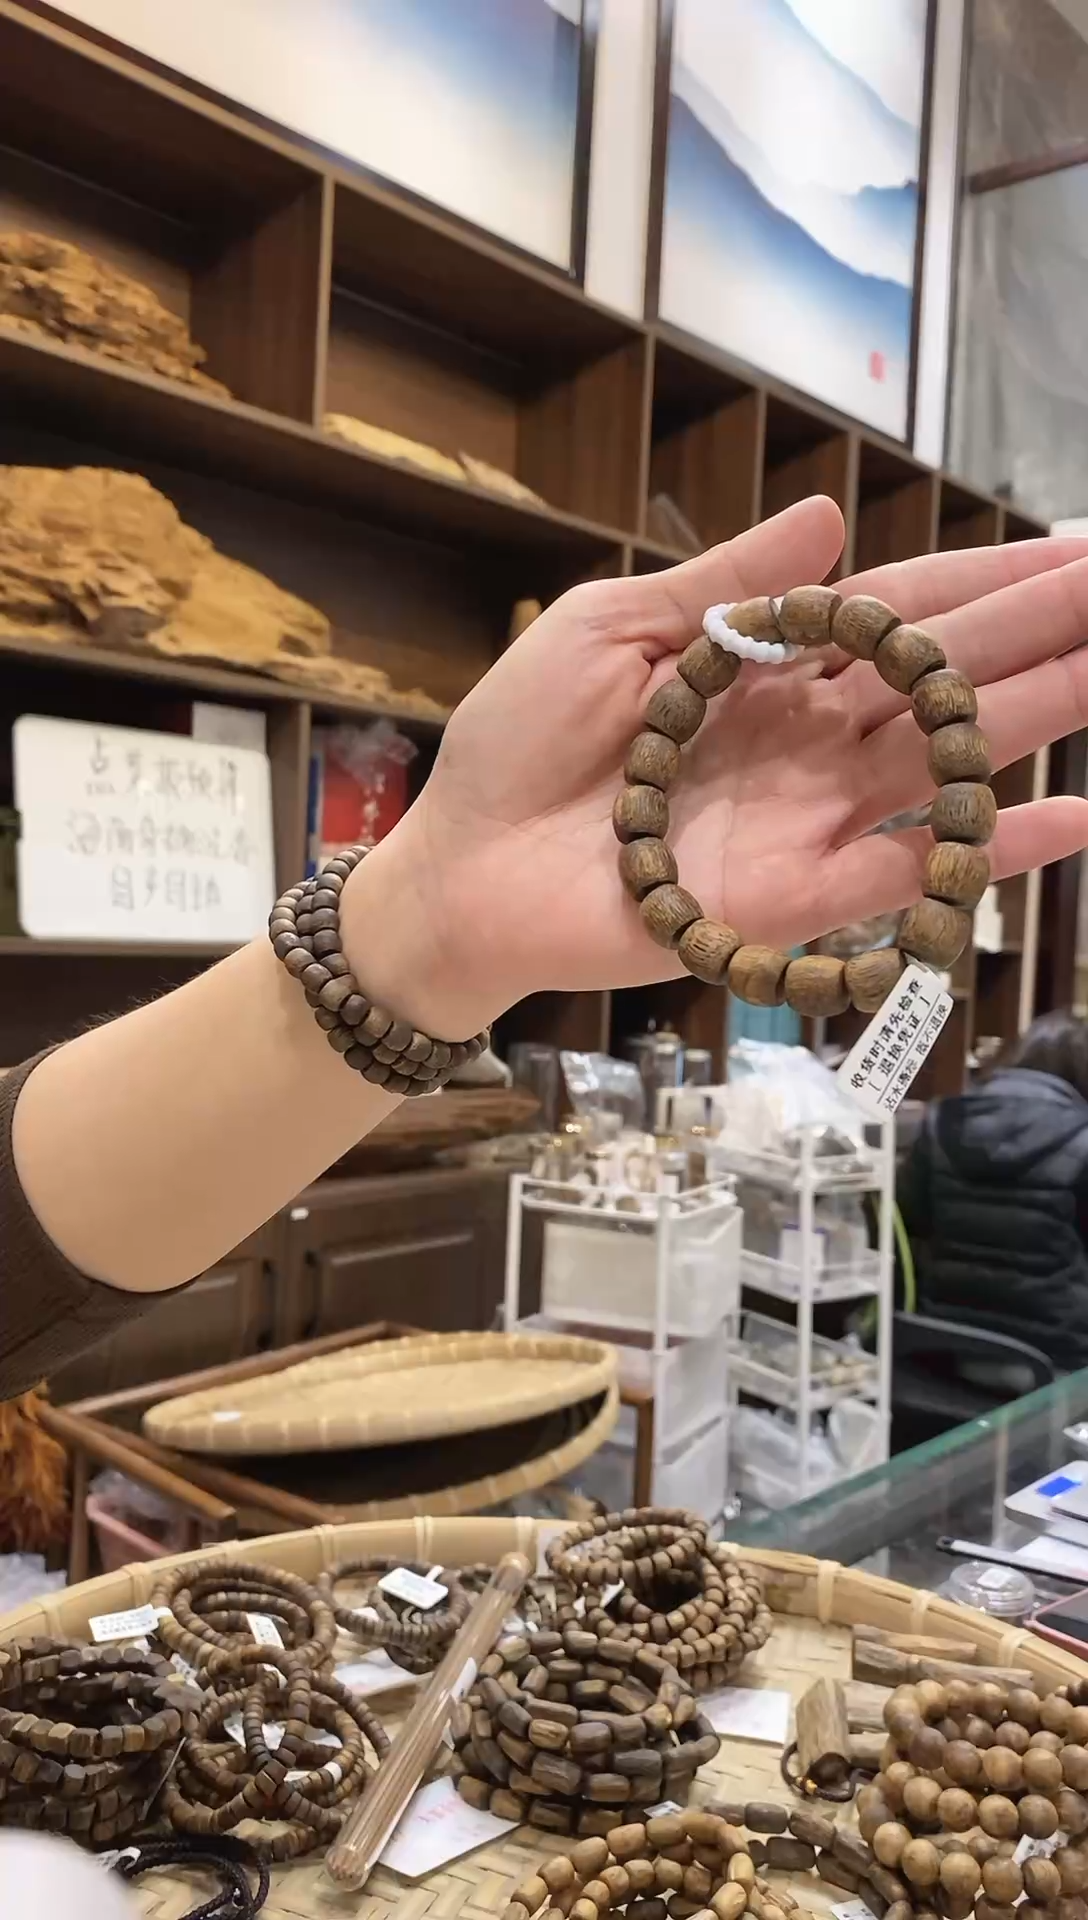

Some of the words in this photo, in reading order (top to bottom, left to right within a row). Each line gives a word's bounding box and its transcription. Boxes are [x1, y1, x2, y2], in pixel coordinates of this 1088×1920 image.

[850, 978, 922, 1089] 收货时请先检查
